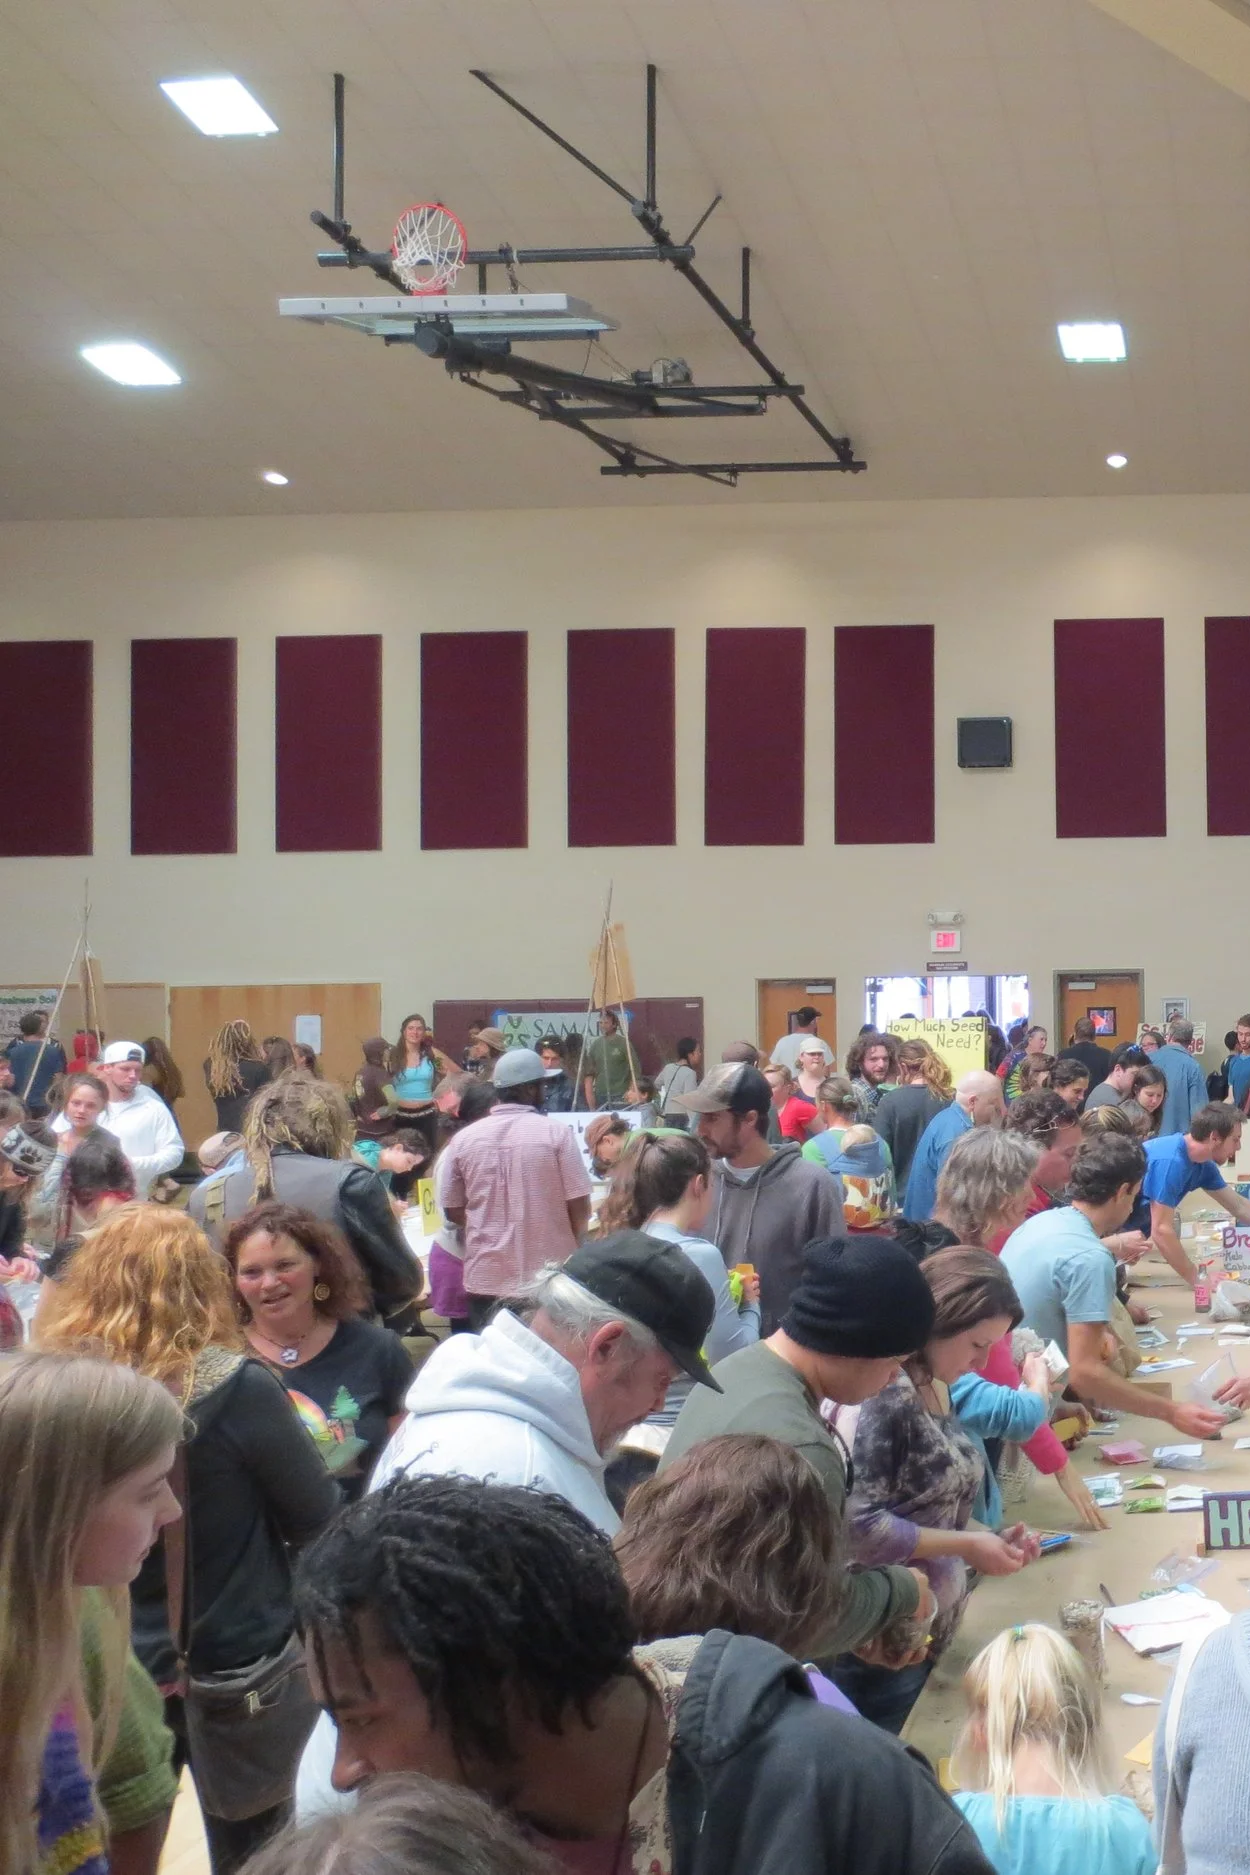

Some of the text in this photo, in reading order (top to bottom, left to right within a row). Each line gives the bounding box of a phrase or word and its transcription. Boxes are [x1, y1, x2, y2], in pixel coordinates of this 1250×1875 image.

[886, 1016, 984, 1033] How Much Seed
[936, 1033, 982, 1051] Need?
